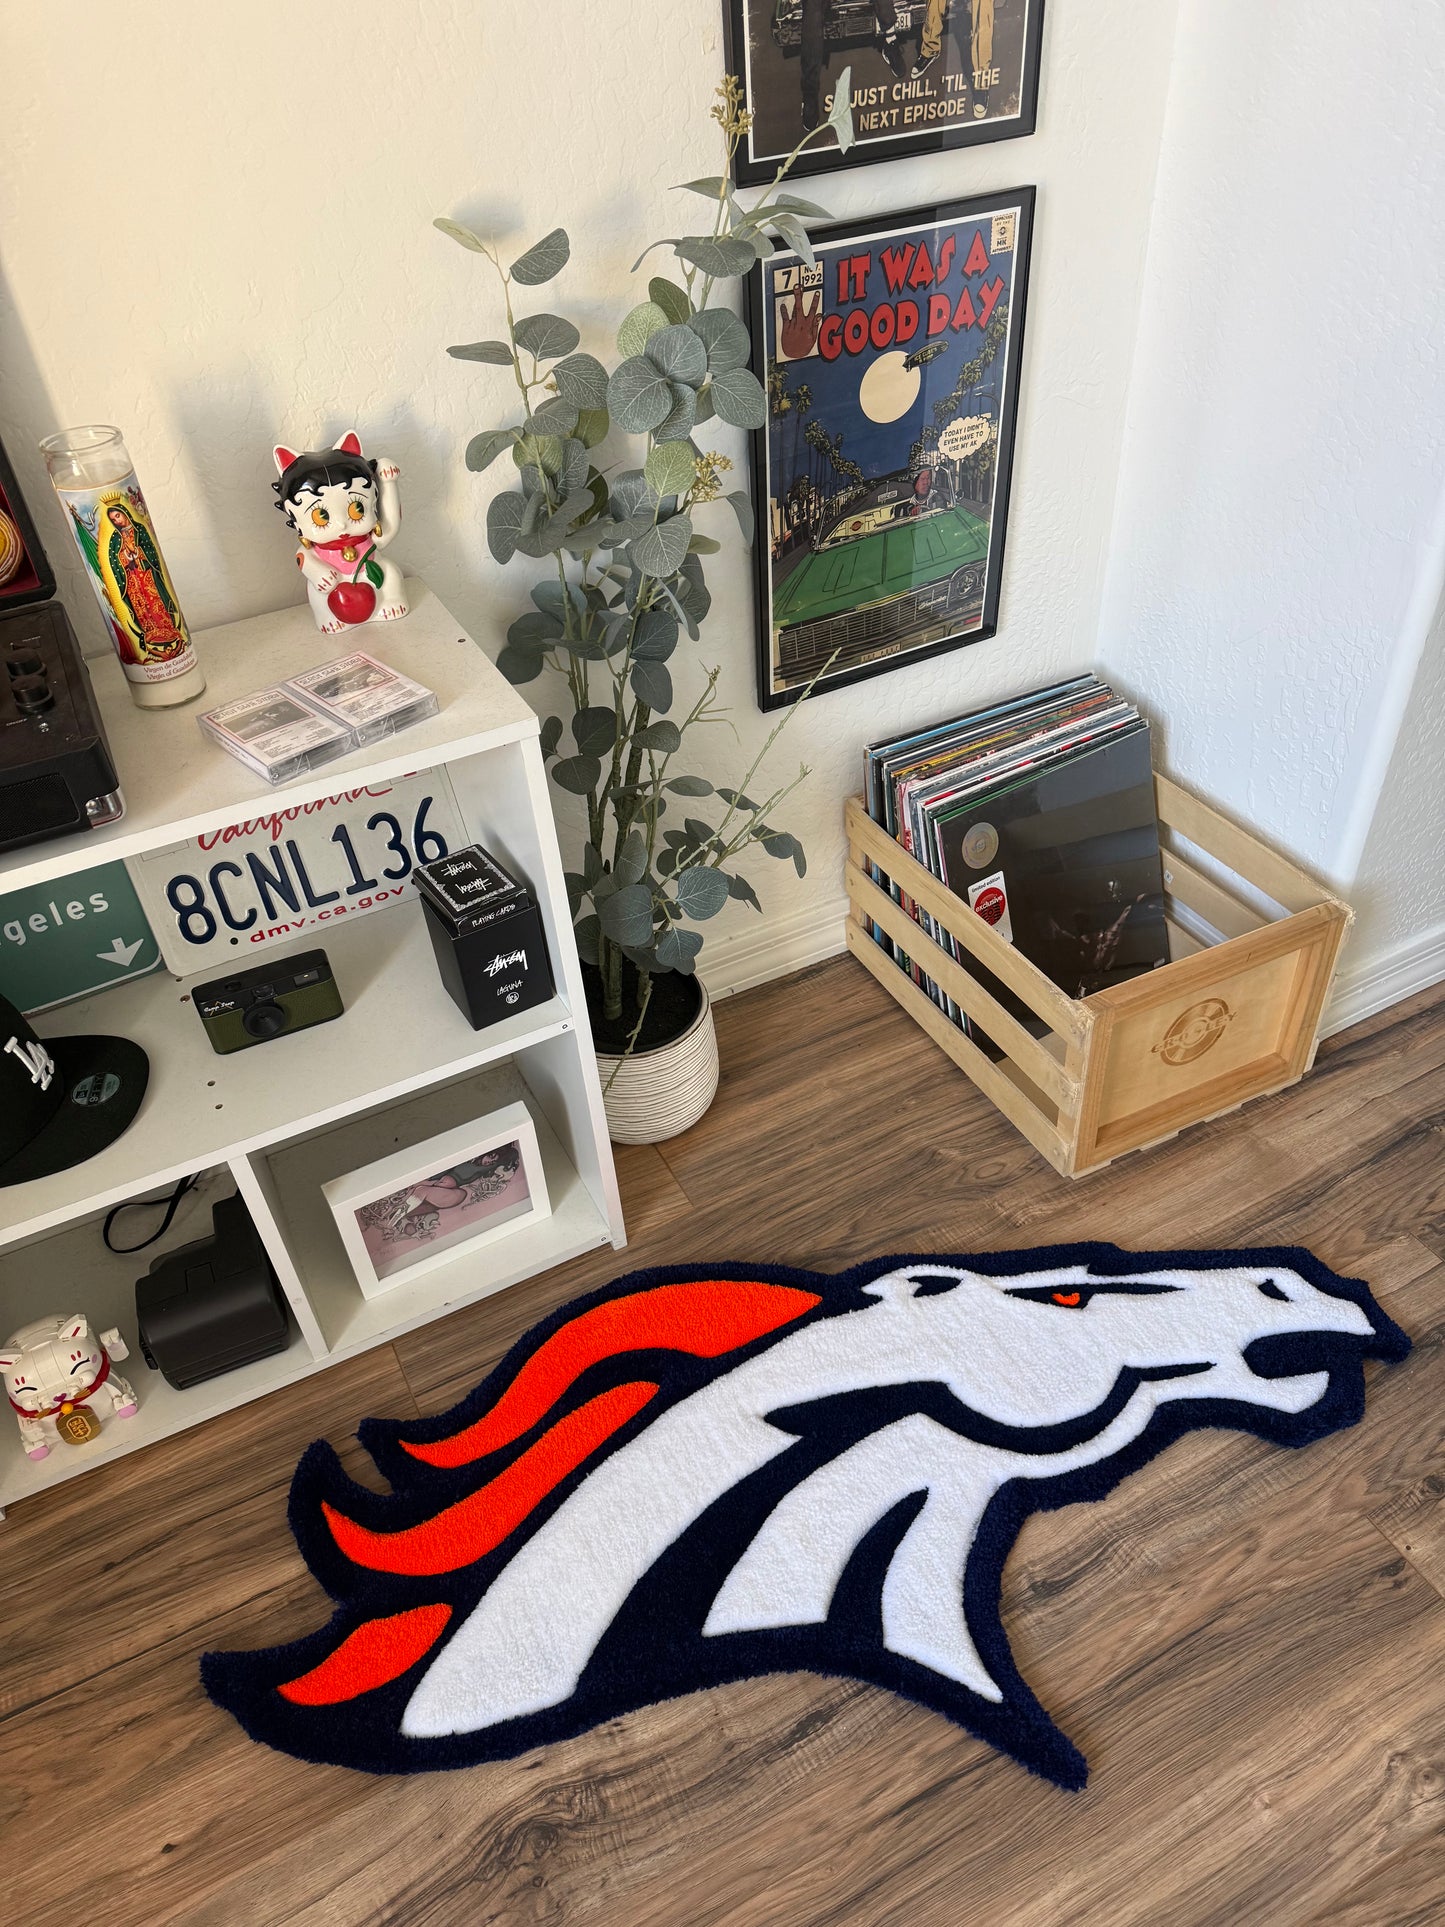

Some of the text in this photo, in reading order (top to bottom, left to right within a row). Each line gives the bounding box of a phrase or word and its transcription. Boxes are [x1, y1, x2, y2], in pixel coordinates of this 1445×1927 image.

[850, 87, 888, 108] JUST
[892, 79, 937, 102] CHILL,
[941, 74, 967, 94] 'TIL
[972, 68, 1001, 91] THE
[859, 98, 966, 132] NEXT EPISODE
[838, 229, 990, 304] IT WAS A
[782, 269, 792, 290] 7
[802, 273, 822, 287] 1992
[820, 274, 1006, 361] GOOD DAY
[944, 427, 963, 438] TODAY
[944, 437, 959, 446] EVEN
[959, 433, 974, 442] HAVE
[948, 444, 960, 452] USE
[165, 662, 172, 670] de
[166, 669, 173, 677] of
[166, 796, 449, 945] 8CNL136
[971, 875, 1001, 893] limited edition
[975, 895, 1004, 913] exclusive
[250, 885, 405, 944] dmv.ca.gov
[471, 903, 516, 928] PLAYING CARDS
[496, 979, 524, 996] LAGUNA
[203, 1004, 220, 1013] Camp
[4, 1036, 55, 1091] LA
